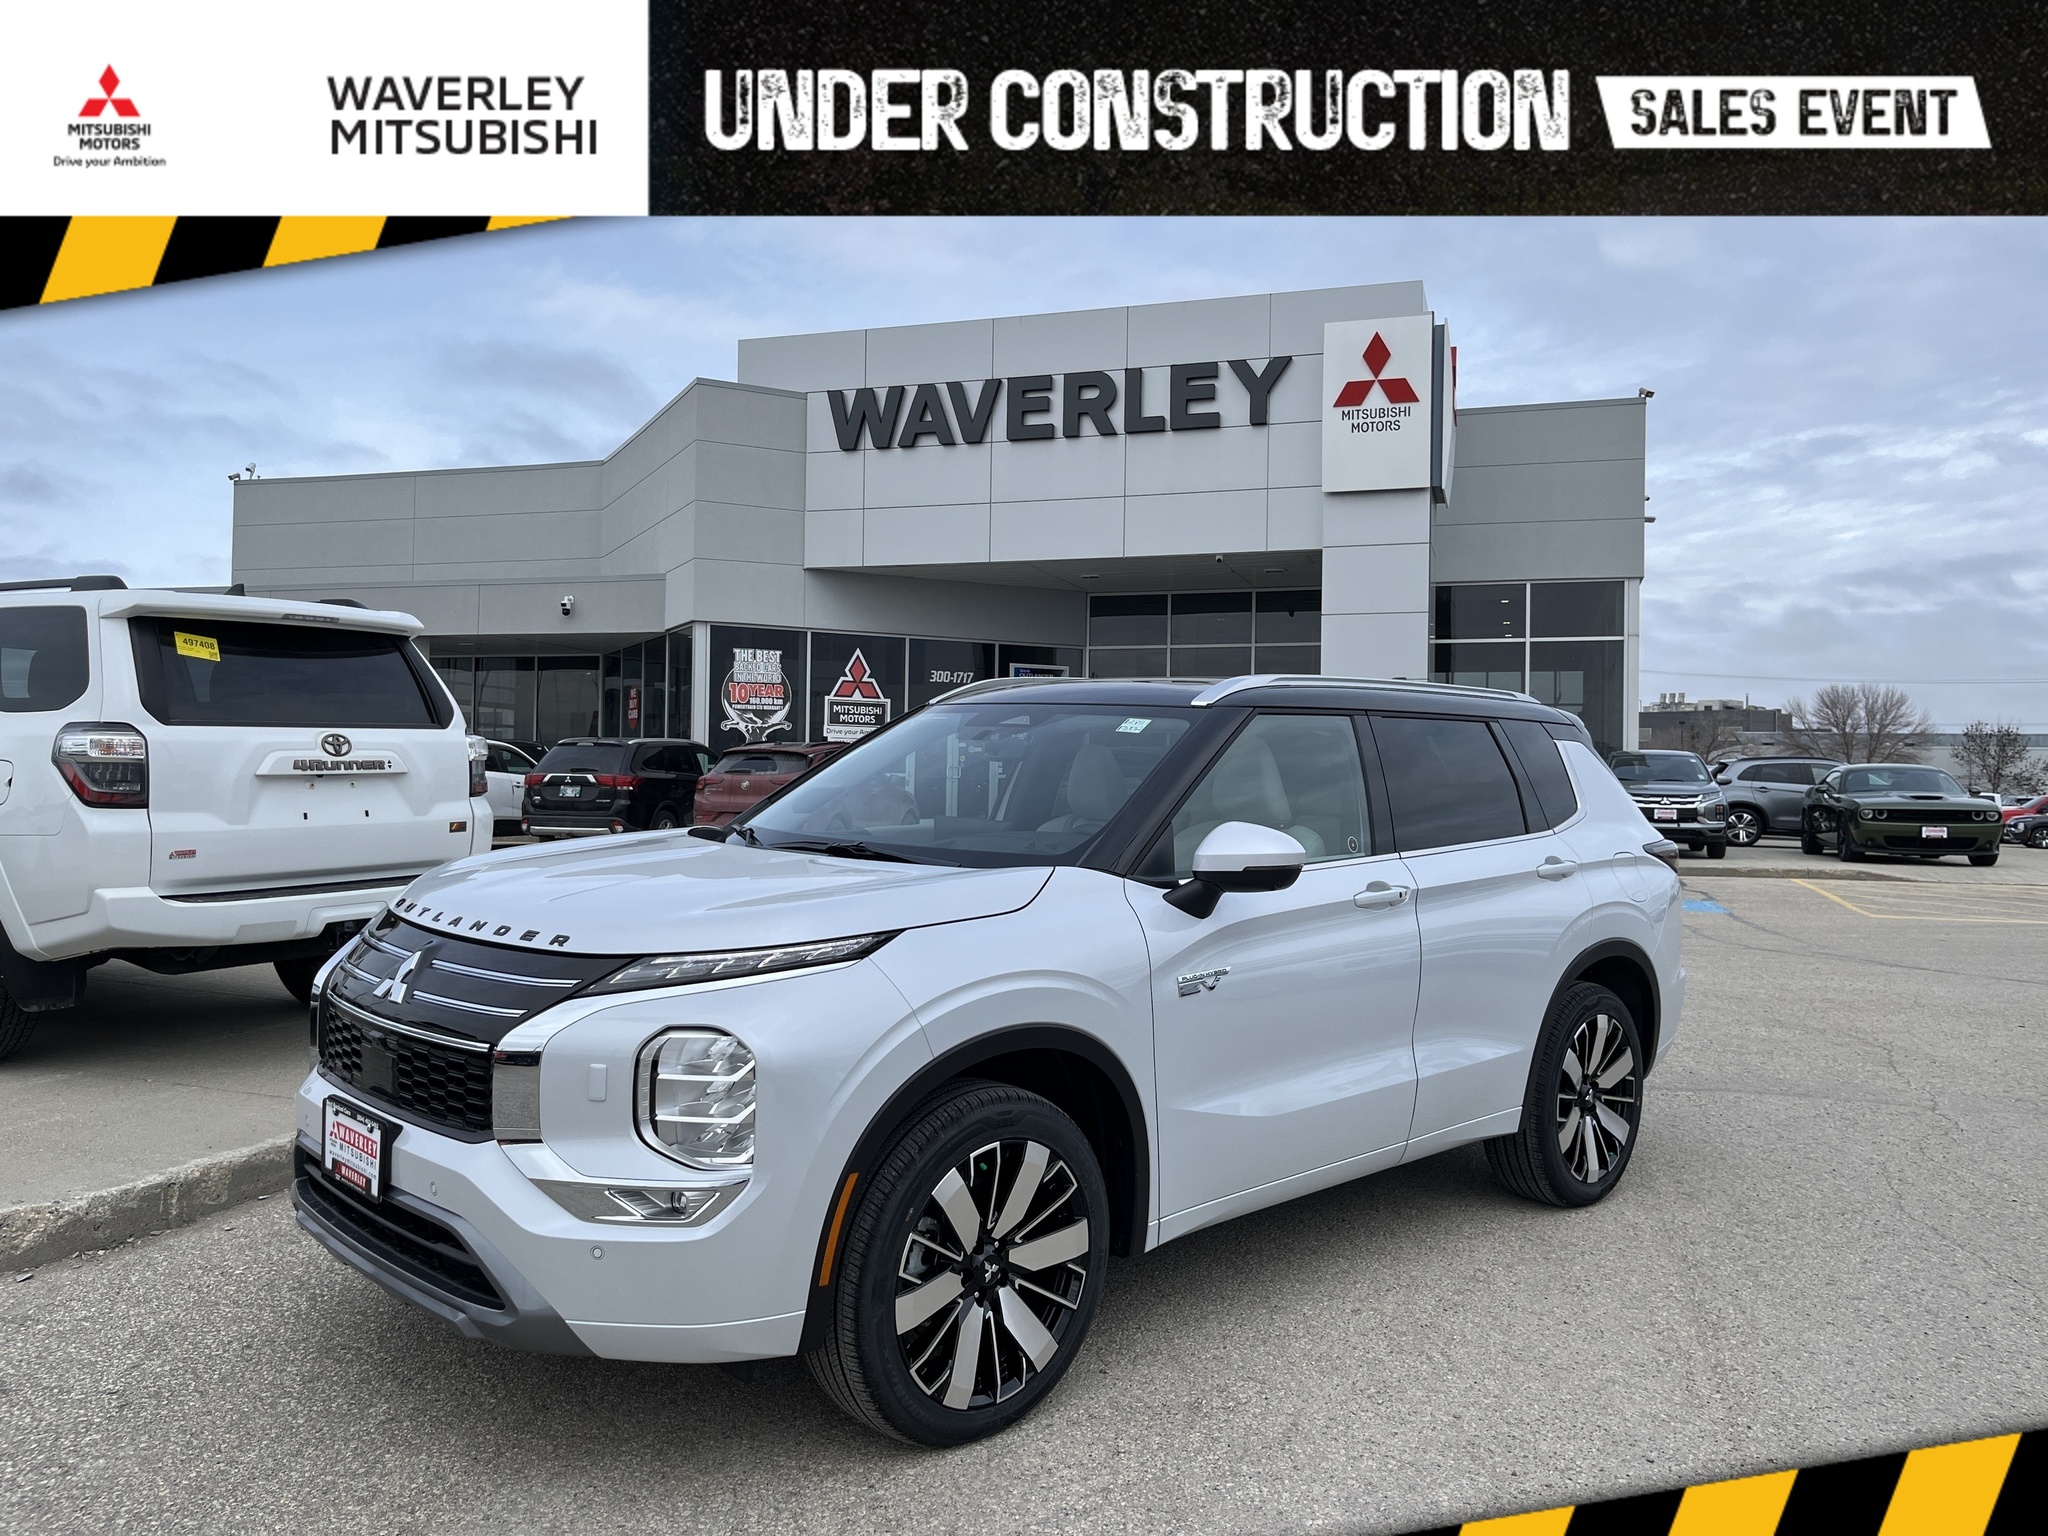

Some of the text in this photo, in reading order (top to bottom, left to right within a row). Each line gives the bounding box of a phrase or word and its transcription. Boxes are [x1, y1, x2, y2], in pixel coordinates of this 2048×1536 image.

[827, 356, 1293, 451] WAVERLEY
[1341, 406, 1411, 421] MITSUBISHI
[1351, 420, 1401, 434] MOTORS
[182, 637, 216, 651] 497408
[735, 648, 782, 663] THE BEST
[929, 670, 974, 684] 300-1717
[729, 683, 784, 703] 10 YEAR
[833, 704, 883, 715] MITSUBISHI
[839, 714, 876, 724] MOTORS
[293, 759, 386, 771] 4RUNNER
[394, 897, 571, 948] OUTLANDER
[339, 1124, 378, 1157] WAVERLEY
[339, 1141, 377, 1171] MITSUBISHI
[341, 1164, 367, 1187] WAVERLEY
